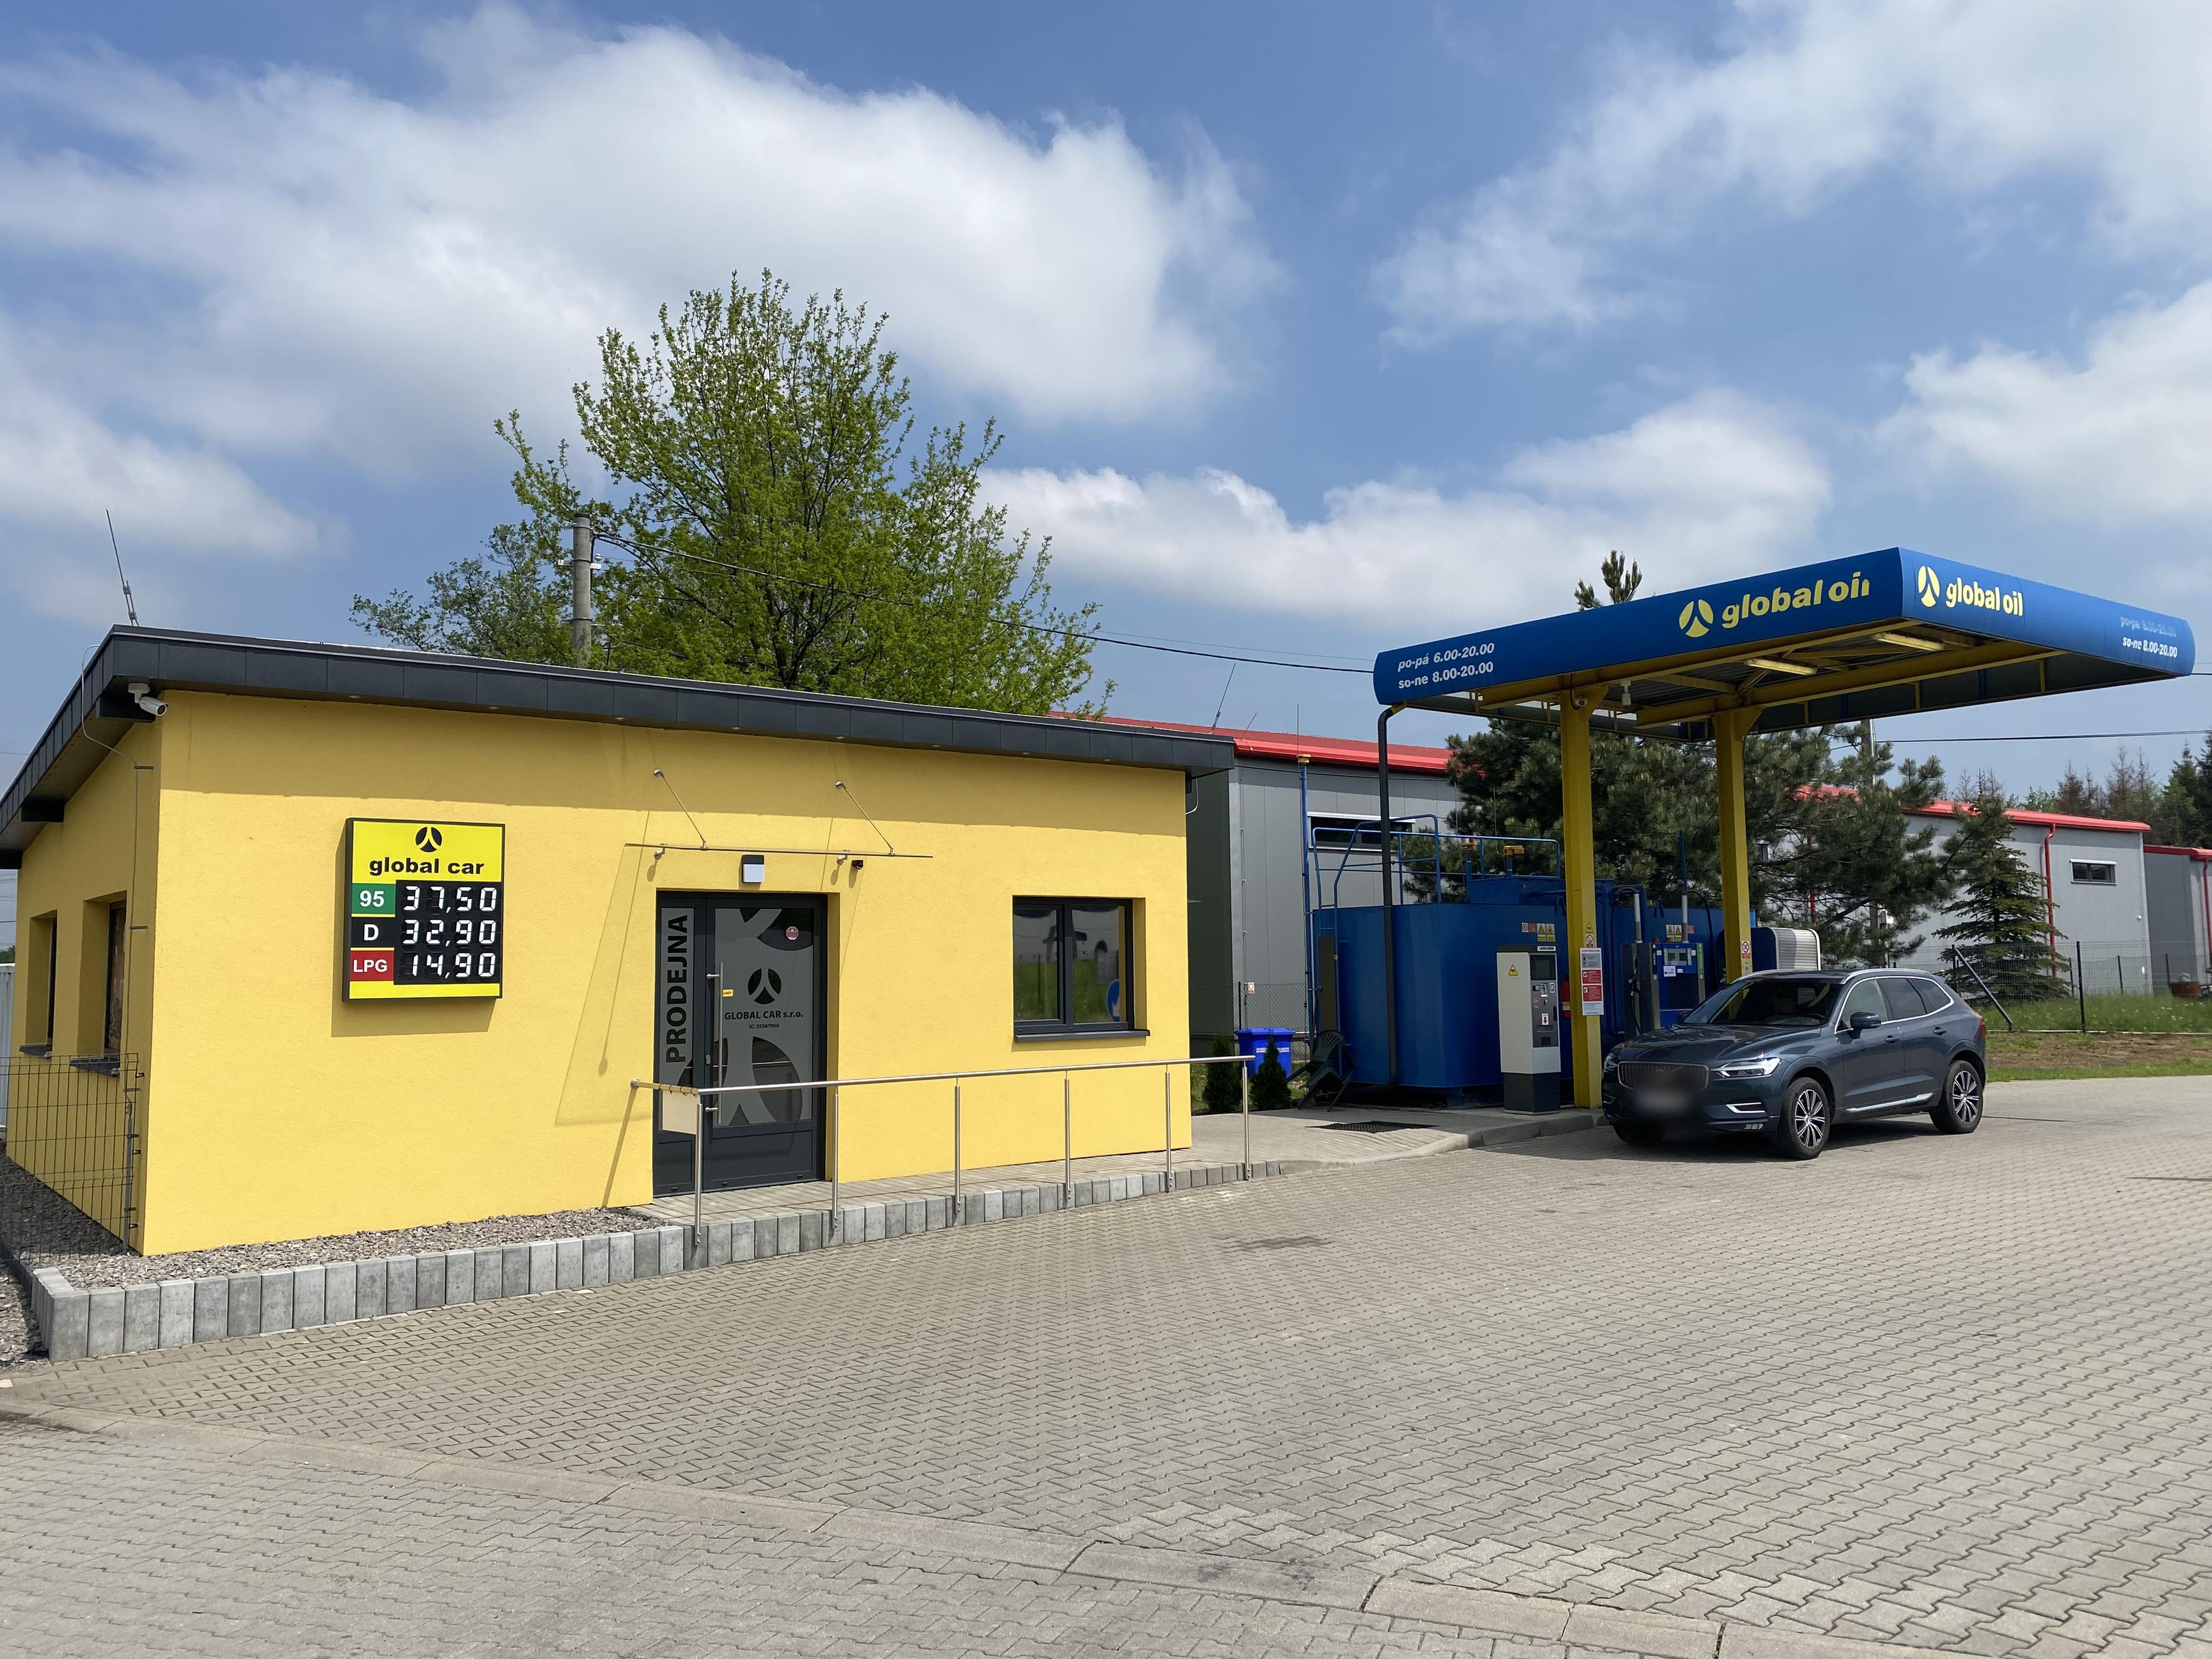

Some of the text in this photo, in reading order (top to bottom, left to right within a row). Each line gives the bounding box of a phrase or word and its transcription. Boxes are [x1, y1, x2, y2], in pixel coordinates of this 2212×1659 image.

[1722, 579, 1823, 628] global
[1945, 577, 2023, 616] global oil
[1398, 643, 1495, 672] po-pá 6.00-20.00
[2122, 637, 2178, 658] so-ne 8.00-20.00
[1398, 661, 1494, 688] so-ne 8.00-20.00
[369, 857, 484, 876] global car
[359, 886, 497, 913] 95 37,50
[363, 920, 497, 947] D 32,90
[353, 953, 495, 979] LPG 14,90
[666, 915, 687, 1063] PRODEJNA
[724, 1011, 760, 1020] GLOBAL
[763, 1010, 781, 1019] CAR
